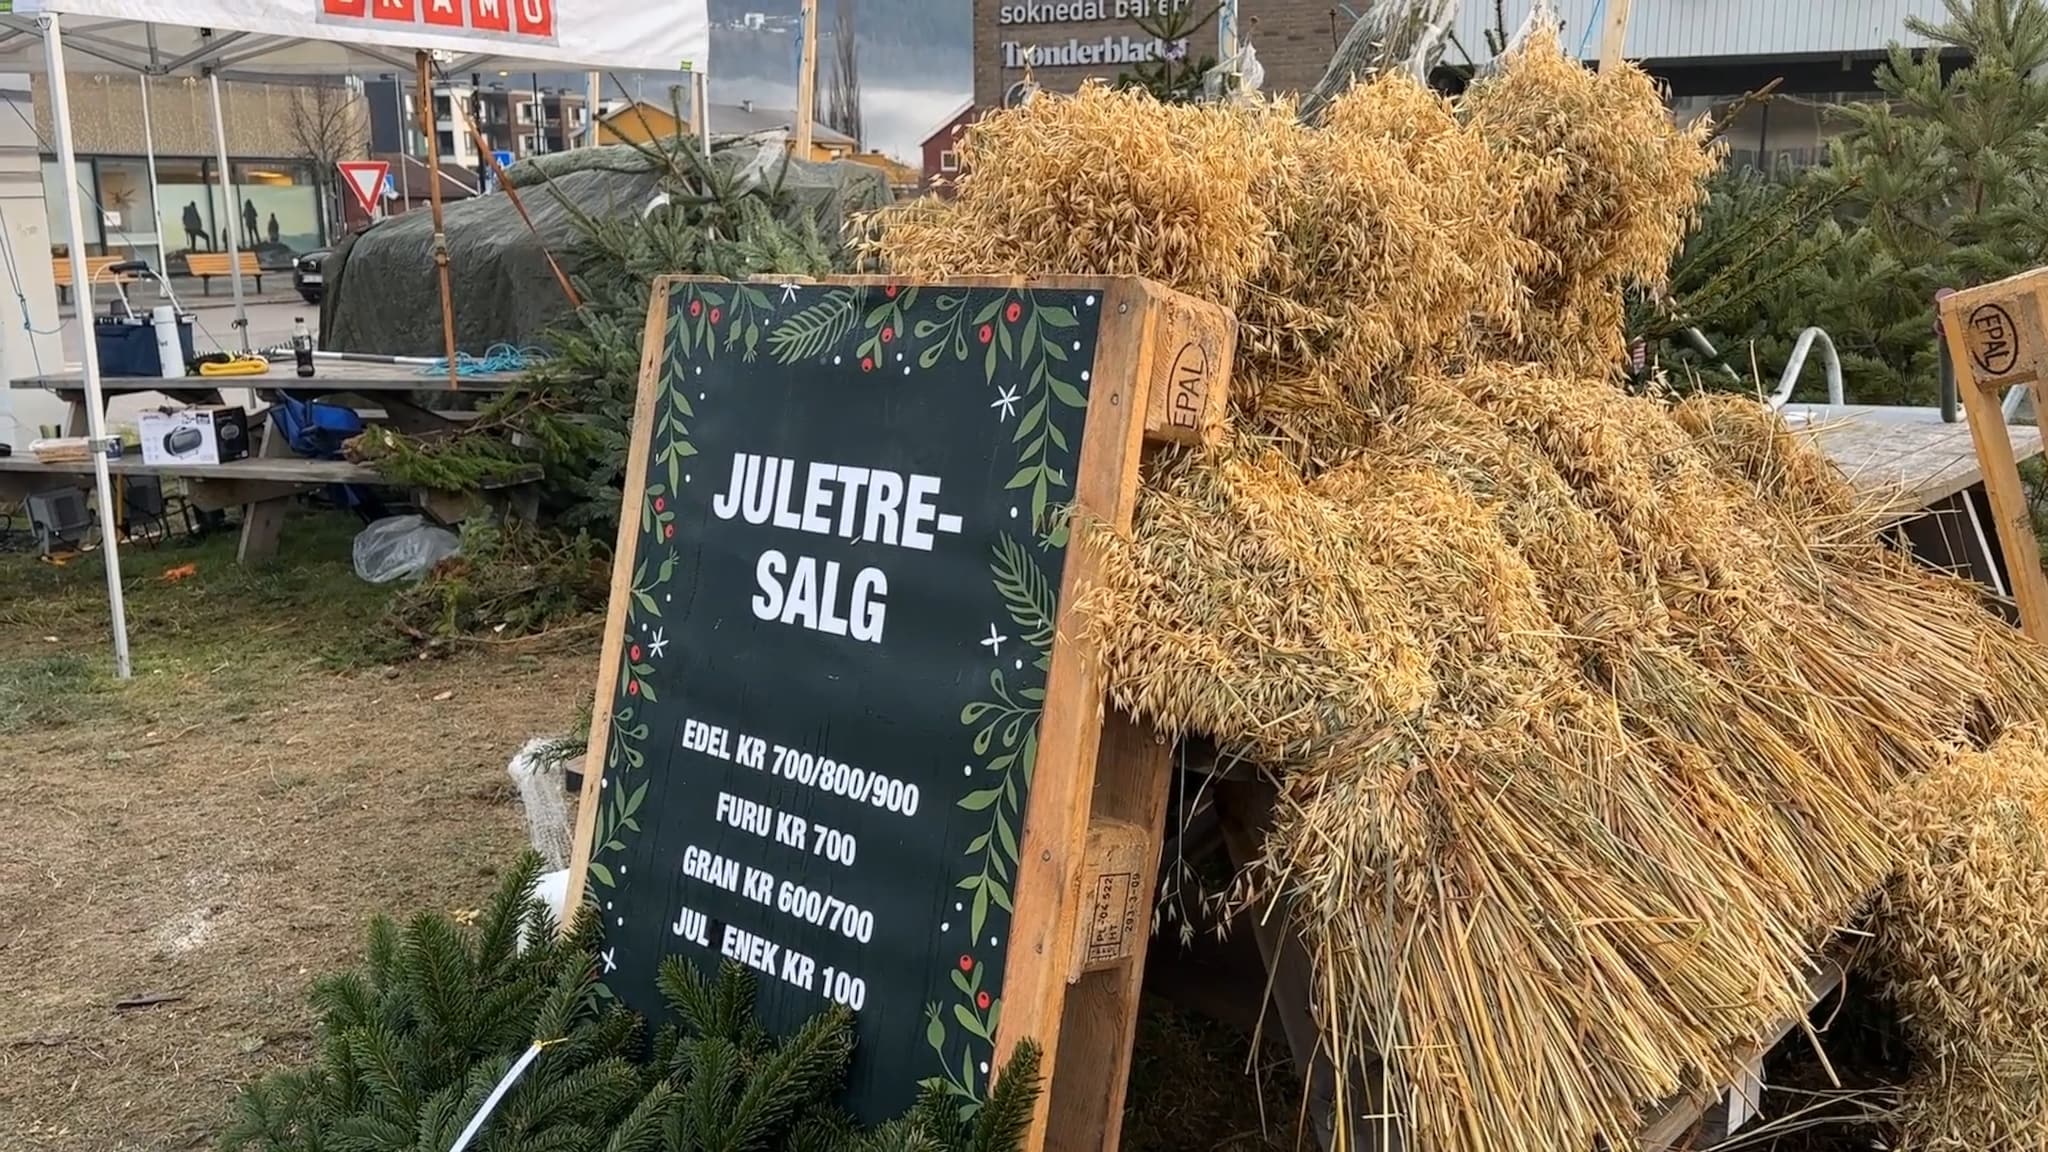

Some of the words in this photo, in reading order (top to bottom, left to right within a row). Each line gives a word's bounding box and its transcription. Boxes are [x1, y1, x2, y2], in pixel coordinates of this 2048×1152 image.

[1000, 0, 1106, 24] soknedal
[1974, 313, 2010, 367] EPAL
[1174, 360, 1204, 429] EPAL
[712, 452, 963, 551] JULETRE-
[752, 549, 888, 644] SALG
[681, 718, 732, 761] EDEL
[735, 734, 767, 771] KR
[772, 744, 919, 817] 700/800/900
[715, 791, 772, 837] FURU
[775, 811, 807, 850] KR
[813, 823, 856, 866] 700
[682, 845, 740, 892] GRAN
[742, 866, 774, 906] KR
[777, 880, 874, 944] 600/700
[782, 948, 816, 991] KR
[822, 966, 866, 1012] 100
